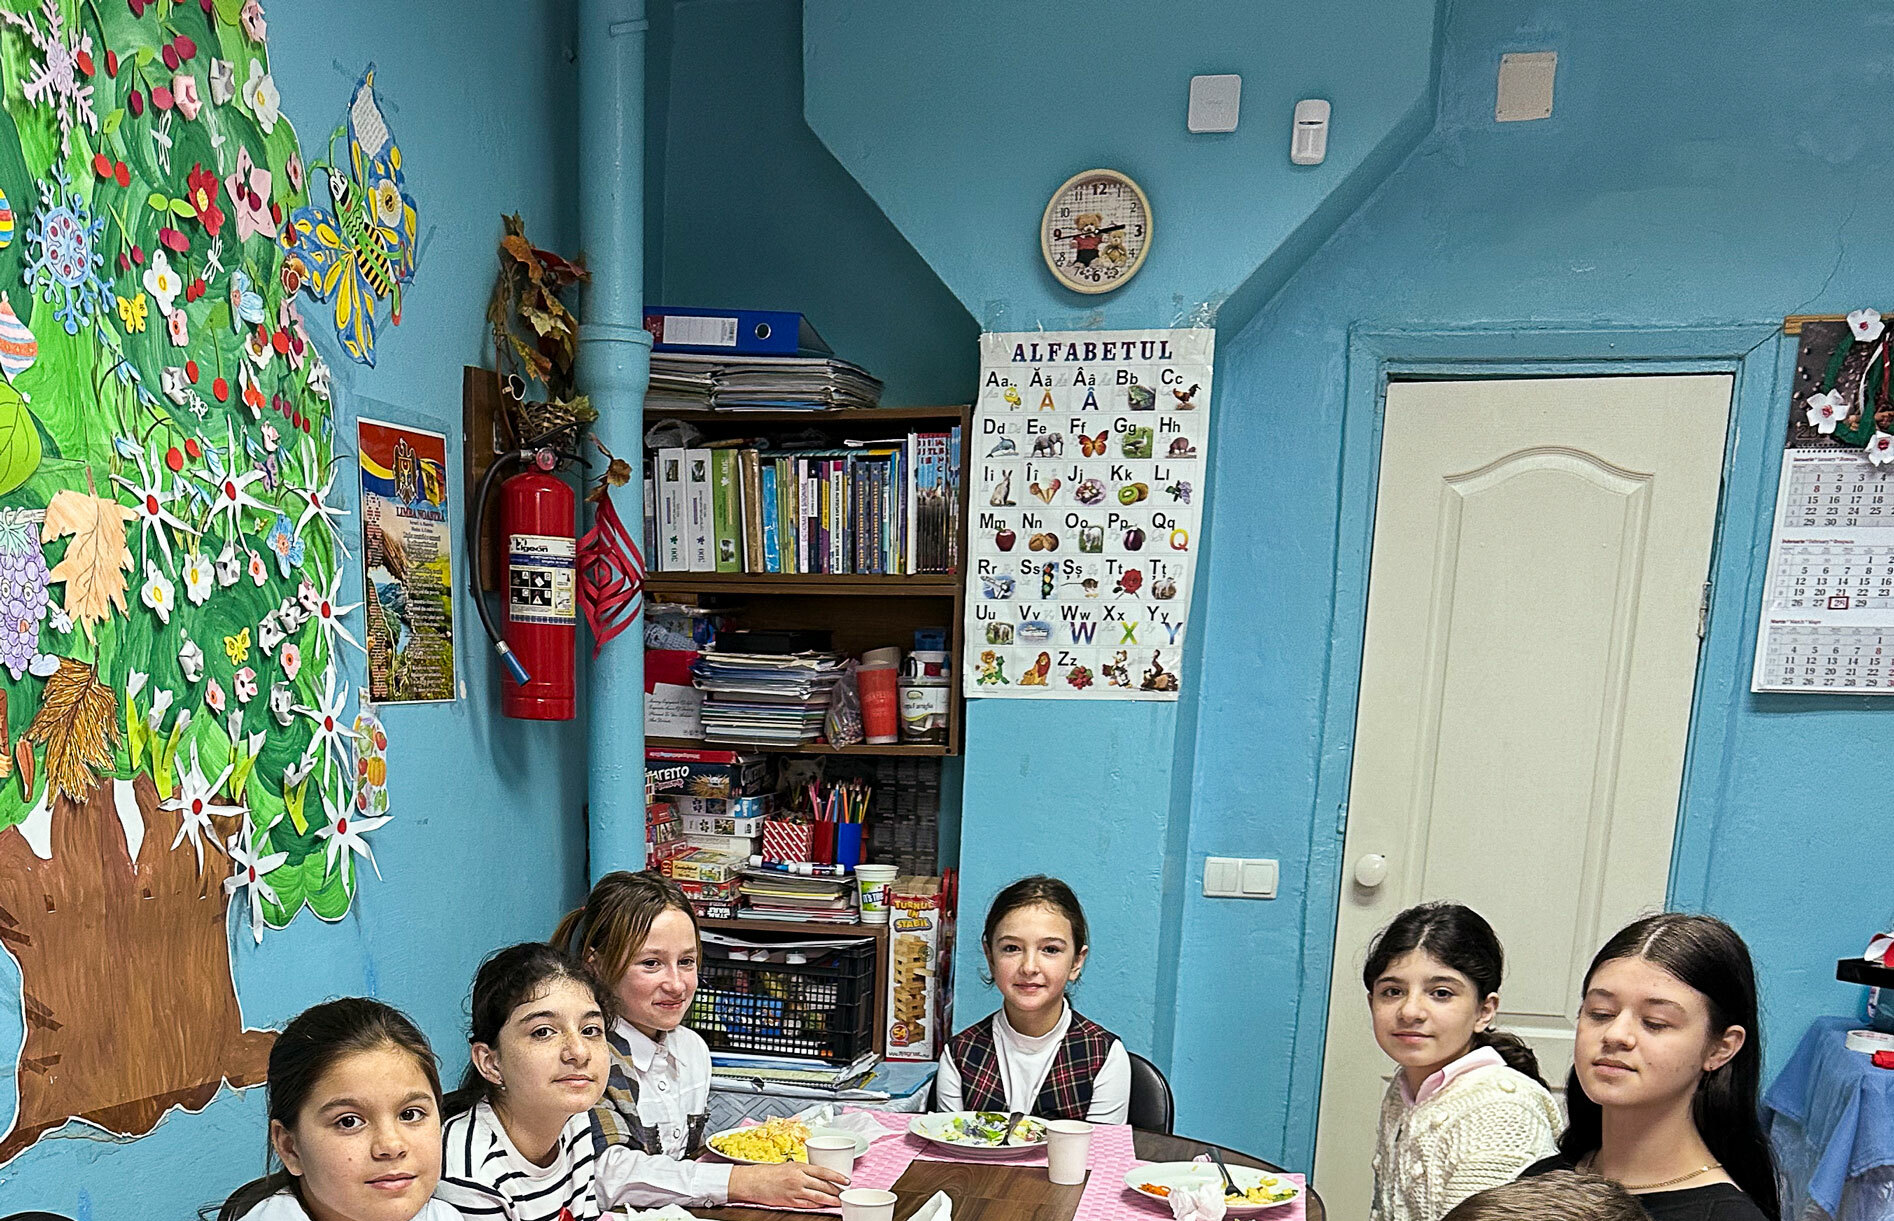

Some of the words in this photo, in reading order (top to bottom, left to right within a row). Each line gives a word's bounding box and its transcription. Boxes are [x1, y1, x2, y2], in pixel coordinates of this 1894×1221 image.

[1092, 183, 1107, 195] 12
[1117, 188, 1120, 197] 1
[1075, 191, 1082, 201] 11
[1061, 208, 1070, 217] 10
[1130, 202, 1136, 212] 2
[1135, 225, 1142, 237] 3
[1129, 248, 1135, 257] 4
[1093, 270, 1100, 282] 6
[1012, 341, 1172, 362] ALFABETUL
[1030, 368, 1052, 387] Ăă
[1073, 367, 1095, 386] Ââ
[1117, 370, 1138, 385] Bb
[1161, 369, 1182, 384] Cc
[983, 419, 1005, 434] Dd
[1027, 419, 1046, 434] Ee
[1070, 419, 1086, 434] Ff
[1114, 418, 1136, 436] Gg
[1160, 417, 1180, 433] Hh
[985, 466, 994, 481] Ii
[1068, 465, 1083, 483] Jj
[1111, 465, 1132, 481] Kk
[1155, 465, 1169, 480] Ll
[1808, 496, 1818, 504] 15
[1829, 496, 1840, 504] 16
[1851, 496, 1861, 504] 17
[1873, 496, 1883, 504] 18
[980, 514, 1006, 529] Mm
[1023, 514, 1042, 529] Nn
[1065, 513, 1088, 528] Oo
[1108, 513, 1128, 531] Pp
[1152, 513, 1175, 531] Qq
[1170, 529, 1188, 551] Q
[978, 560, 997, 574] Rr
[1020, 560, 1040, 574] Ss
[1106, 560, 1123, 574] Tt
[1794, 589, 1804, 597] 19
[1814, 589, 1826, 597] 20
[1857, 589, 1868, 597] 22
[1878, 589, 1890, 597] 23
[976, 605, 996, 620] Uu
[1019, 605, 1040, 620] Vv
[1061, 605, 1090, 620] Ww
[1103, 605, 1125, 621] Xx
[1147, 606, 1168, 623] Yy
[1070, 622, 1096, 645] W
[1120, 621, 1138, 644] X
[1163, 622, 1183, 645] Y
[1875, 647, 1881, 655] 8
[1058, 651, 1077, 666] Zz
